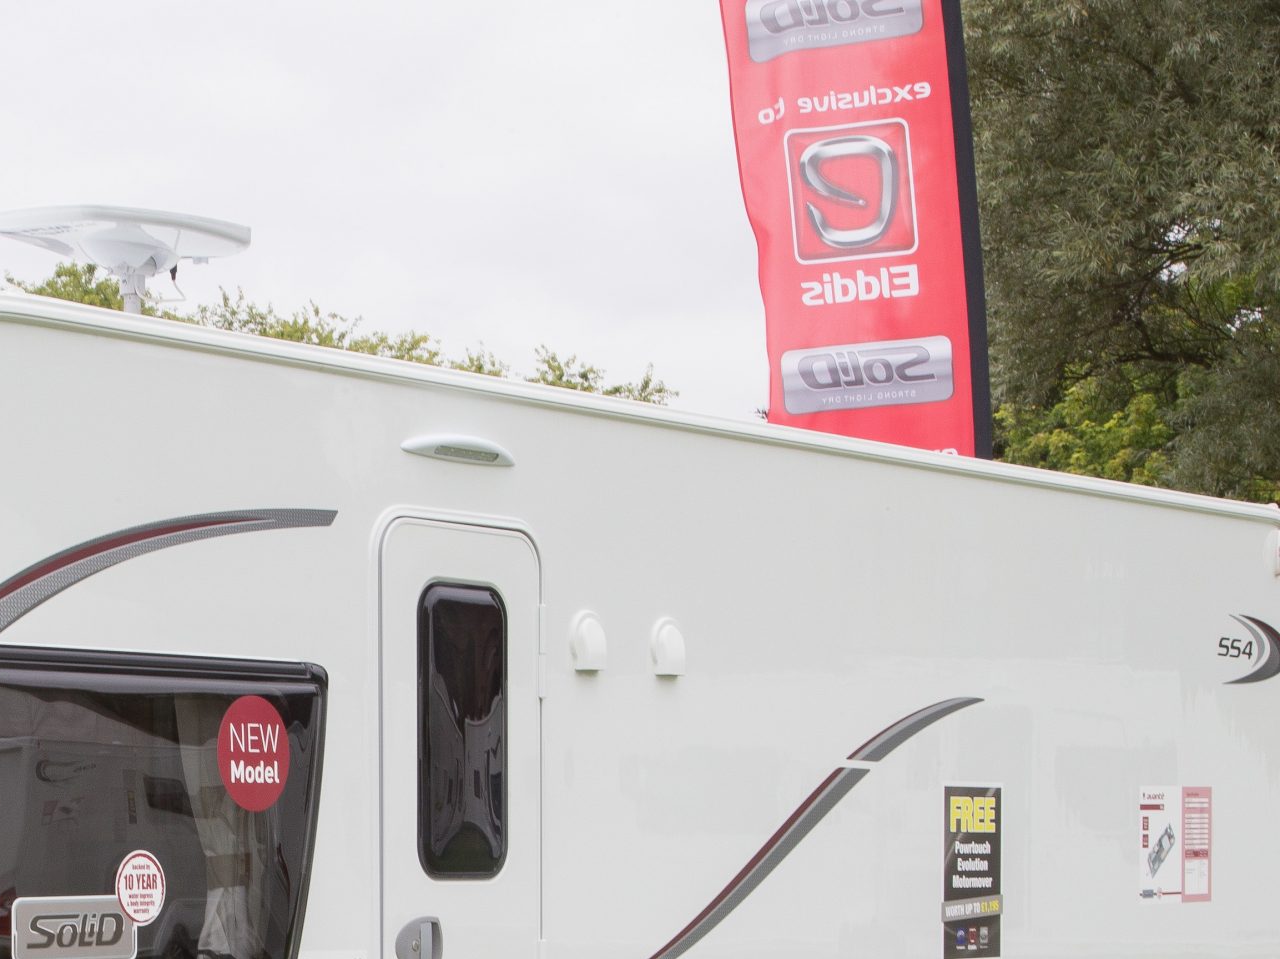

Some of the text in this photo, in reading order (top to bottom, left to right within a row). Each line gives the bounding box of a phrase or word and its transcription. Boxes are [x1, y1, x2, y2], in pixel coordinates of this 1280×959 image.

[1217, 637, 1253, 660] 554
[229, 722, 280, 753] NEW
[230, 760, 280, 784] Model
[950, 796, 996, 833] FREE
[957, 858, 989, 871] Evolution
[124, 873, 158, 890] 10 YEAR
[952, 875, 993, 888] Motormover
[965, 903, 973, 915] UP
[973, 902, 981, 913] TO
